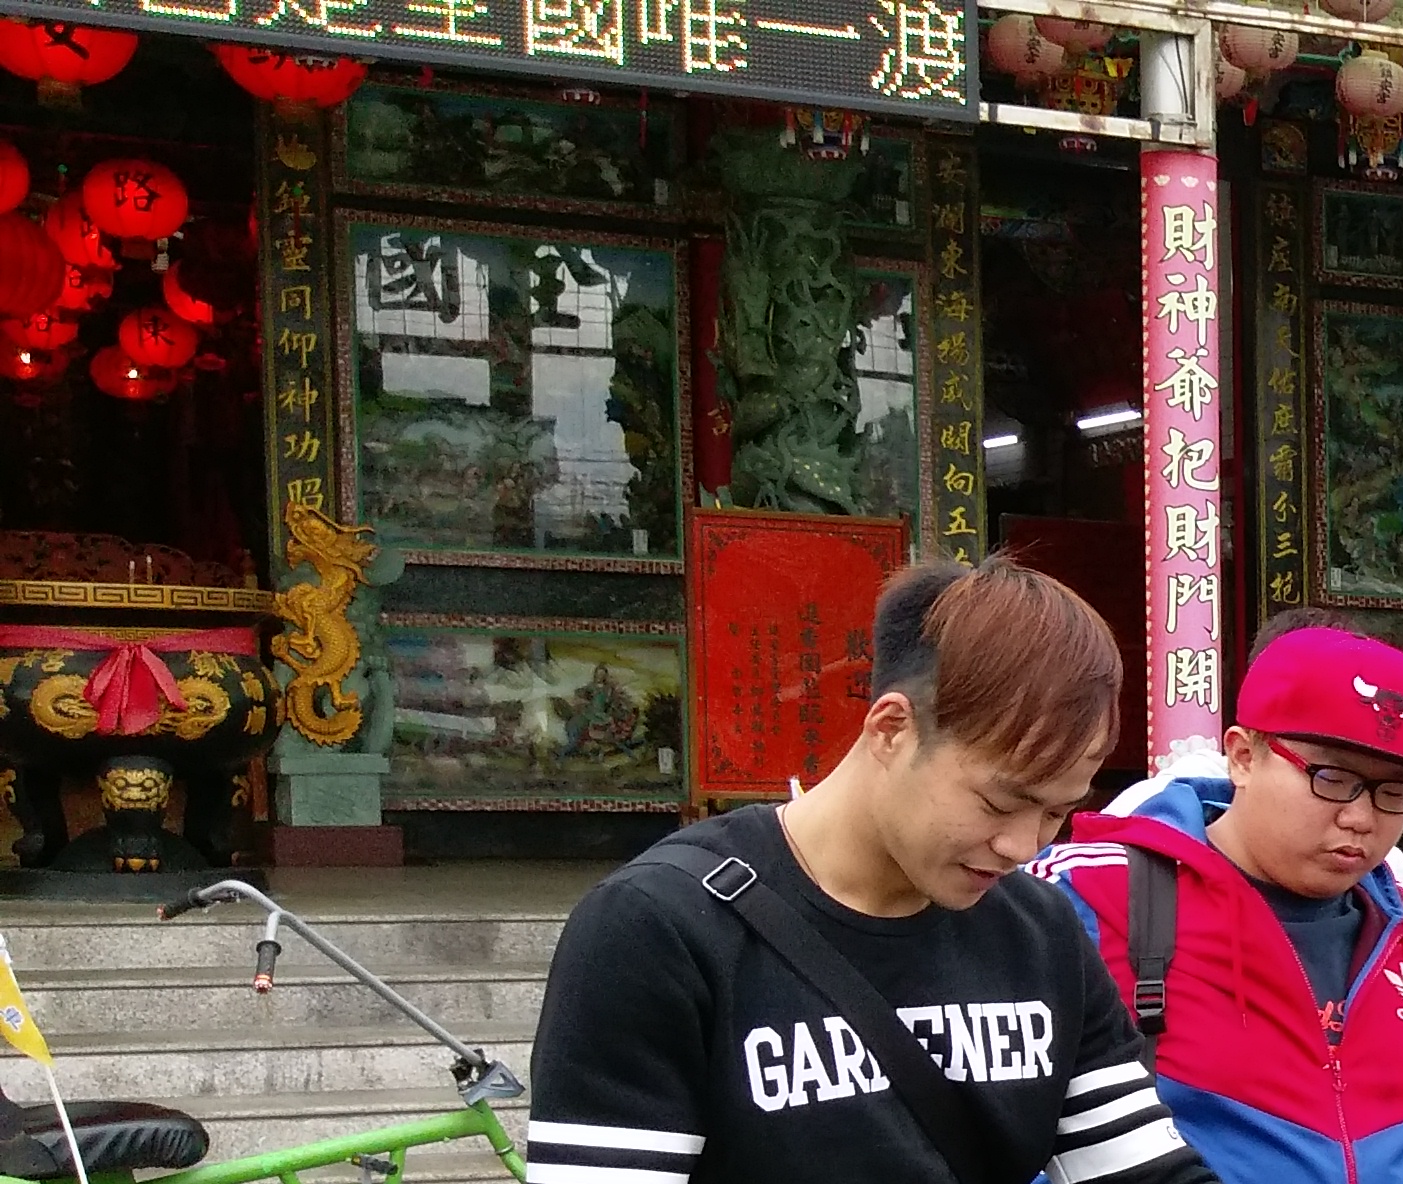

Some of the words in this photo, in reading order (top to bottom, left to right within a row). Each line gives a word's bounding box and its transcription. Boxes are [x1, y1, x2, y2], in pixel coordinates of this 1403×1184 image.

[1153, 202, 1221, 715] 財神爺把財門開
[744, 1001, 1053, 1112] GARENER
